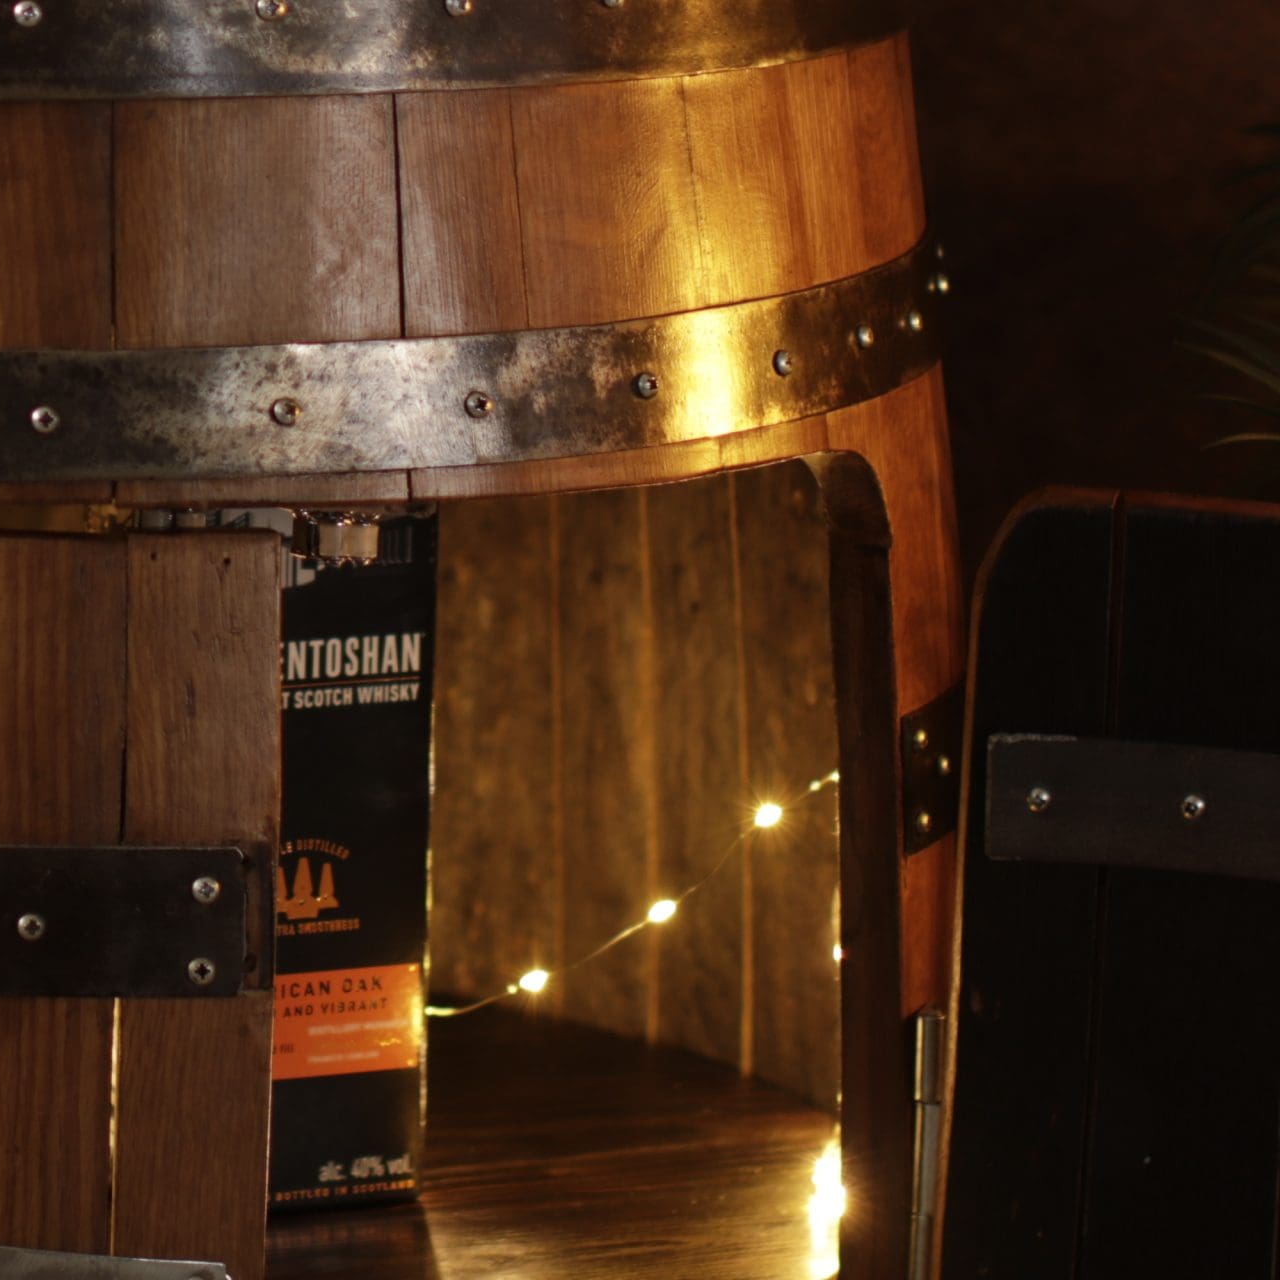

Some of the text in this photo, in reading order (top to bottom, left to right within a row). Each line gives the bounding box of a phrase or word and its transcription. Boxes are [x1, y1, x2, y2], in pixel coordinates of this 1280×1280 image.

[294, 687, 353, 709] SCOTCH
[357, 683, 420, 704] WHISKY
[275, 975, 383, 999] ICAN OAK
[283, 997, 388, 1018] AND VIBRANT
[275, 1189, 330, 1201] BOTTLED
[352, 1179, 416, 1194] SCOTLAND
